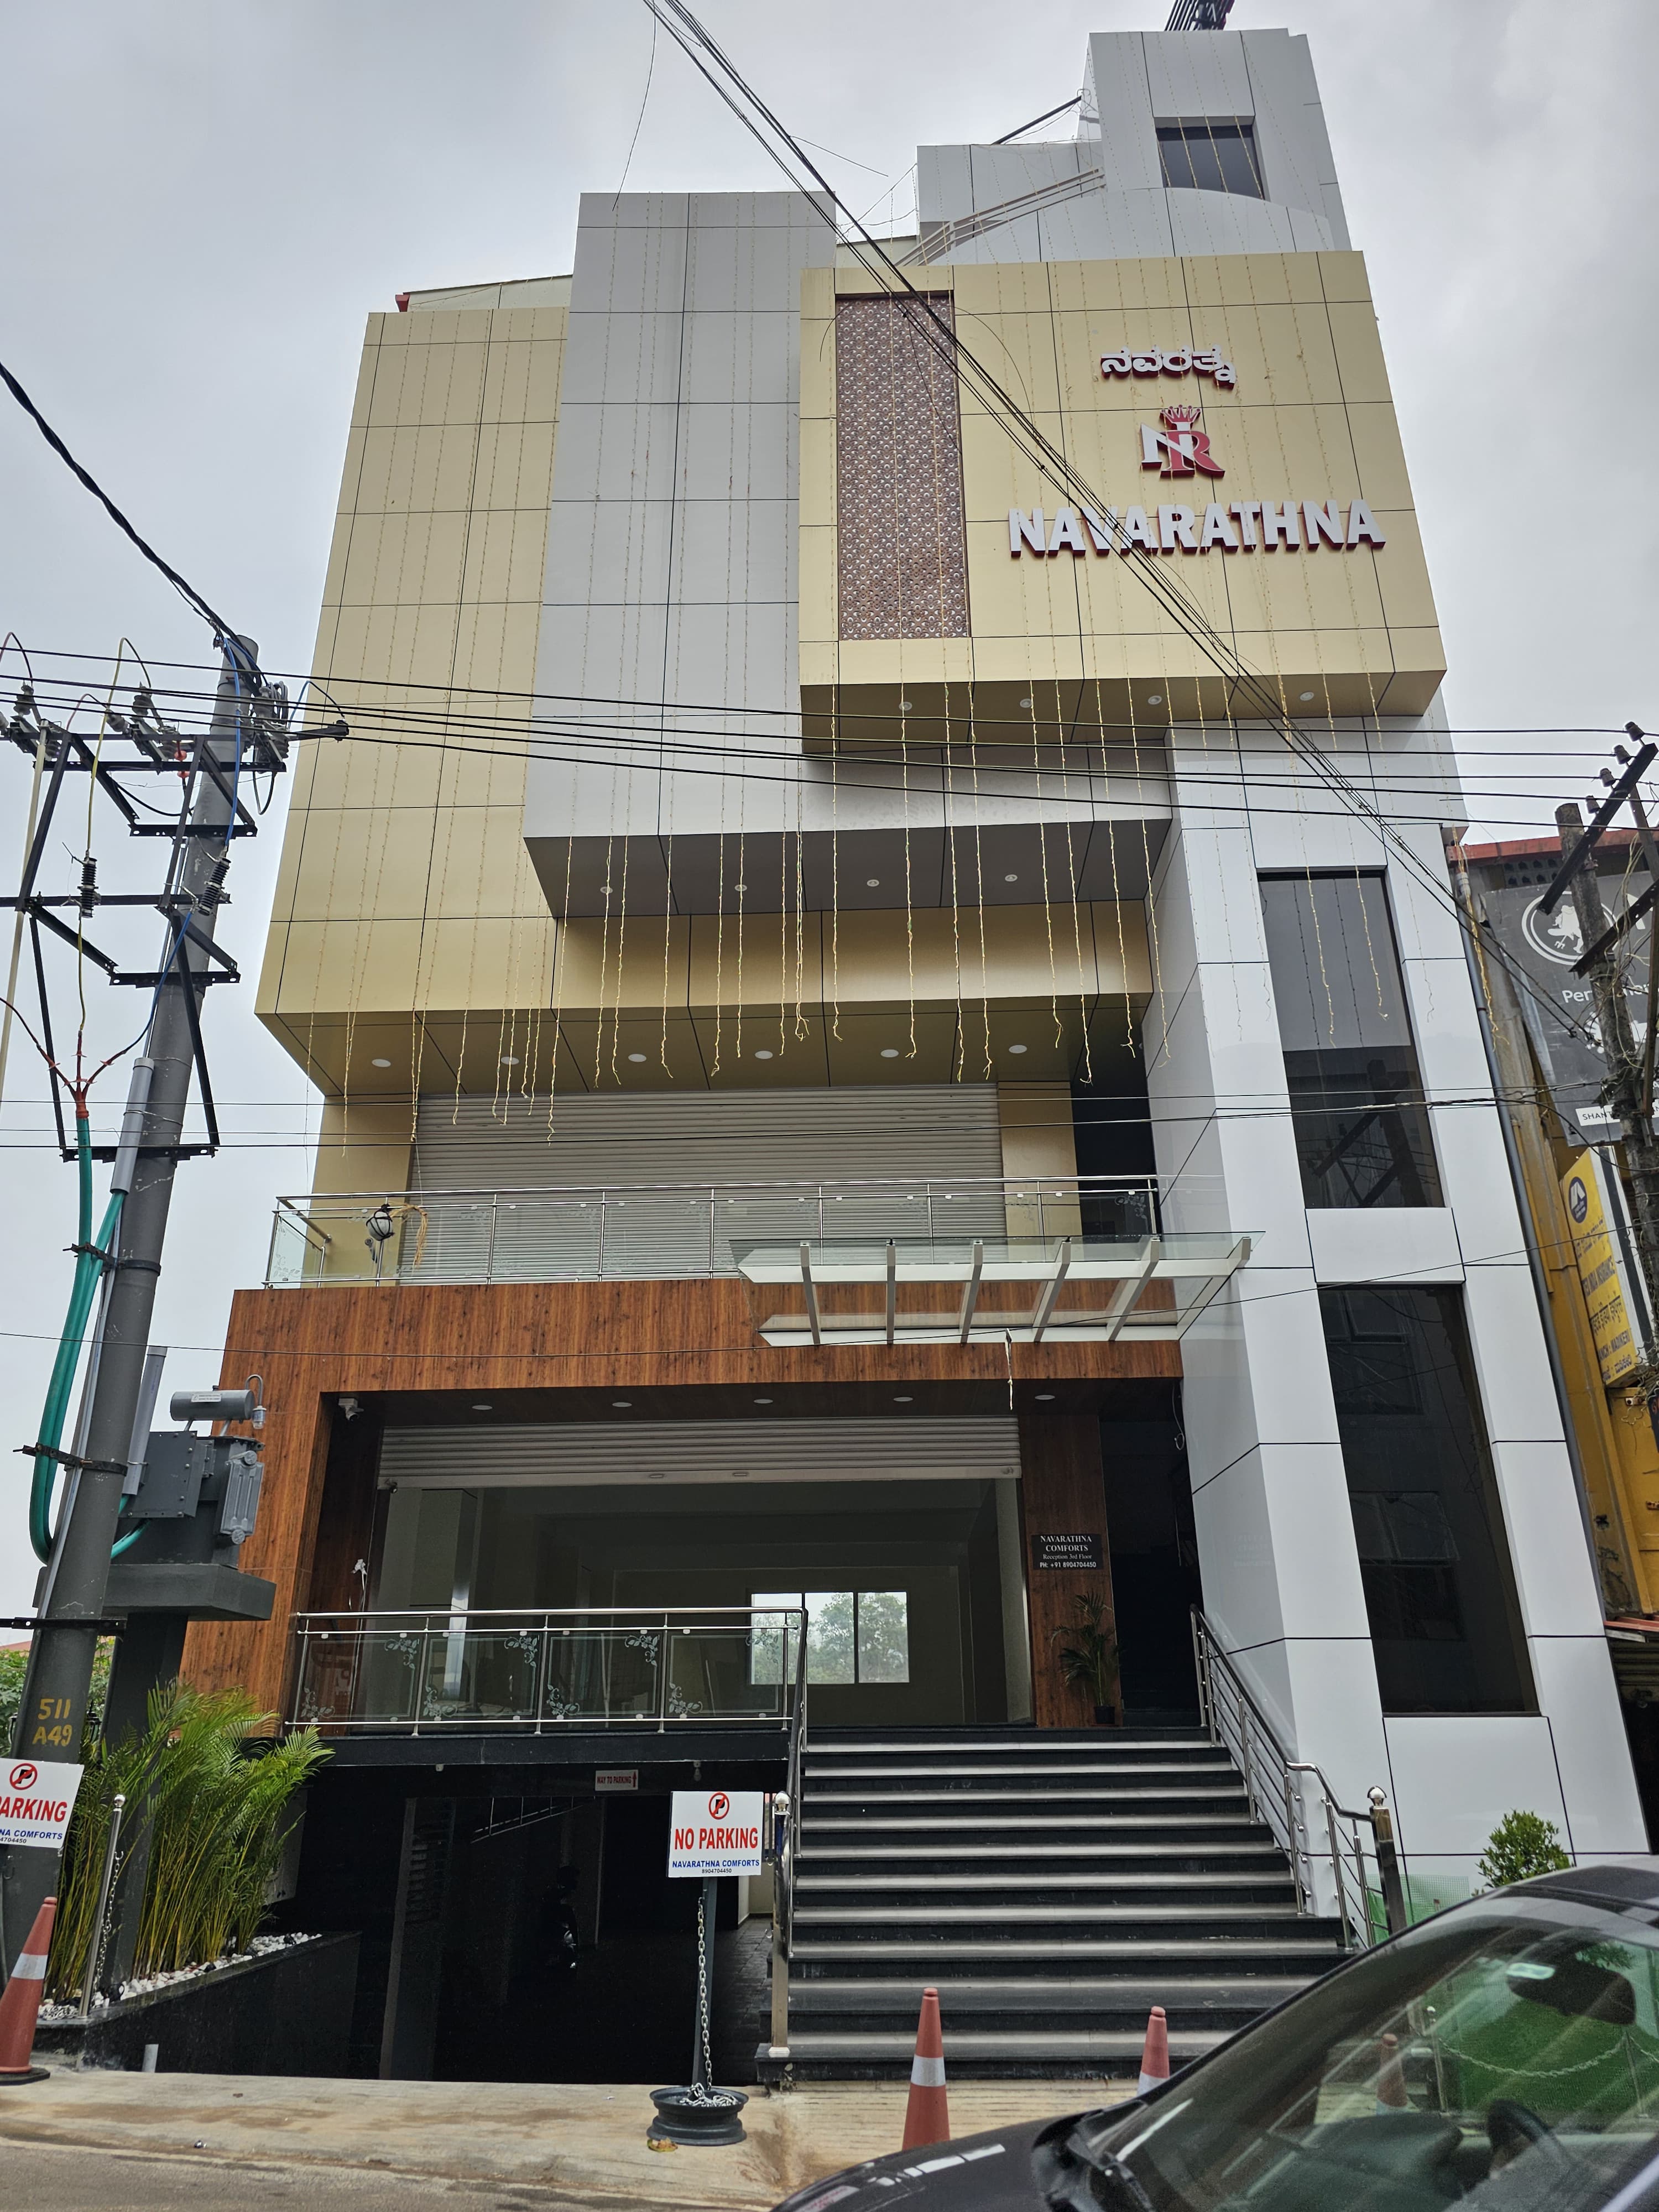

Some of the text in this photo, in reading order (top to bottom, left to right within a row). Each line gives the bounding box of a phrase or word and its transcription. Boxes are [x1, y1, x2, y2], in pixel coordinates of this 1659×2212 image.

[1009, 499, 1386, 557] NAVARATHNA
[38, 1698, 71, 1720] 511
[32, 1724, 72, 1746] A49
[14, 1829, 62, 1840] COMFORTS
[674, 1827, 758, 1850] NO PARKING
[672, 1859, 760, 1868] NAVARATHNA COMFORTS
